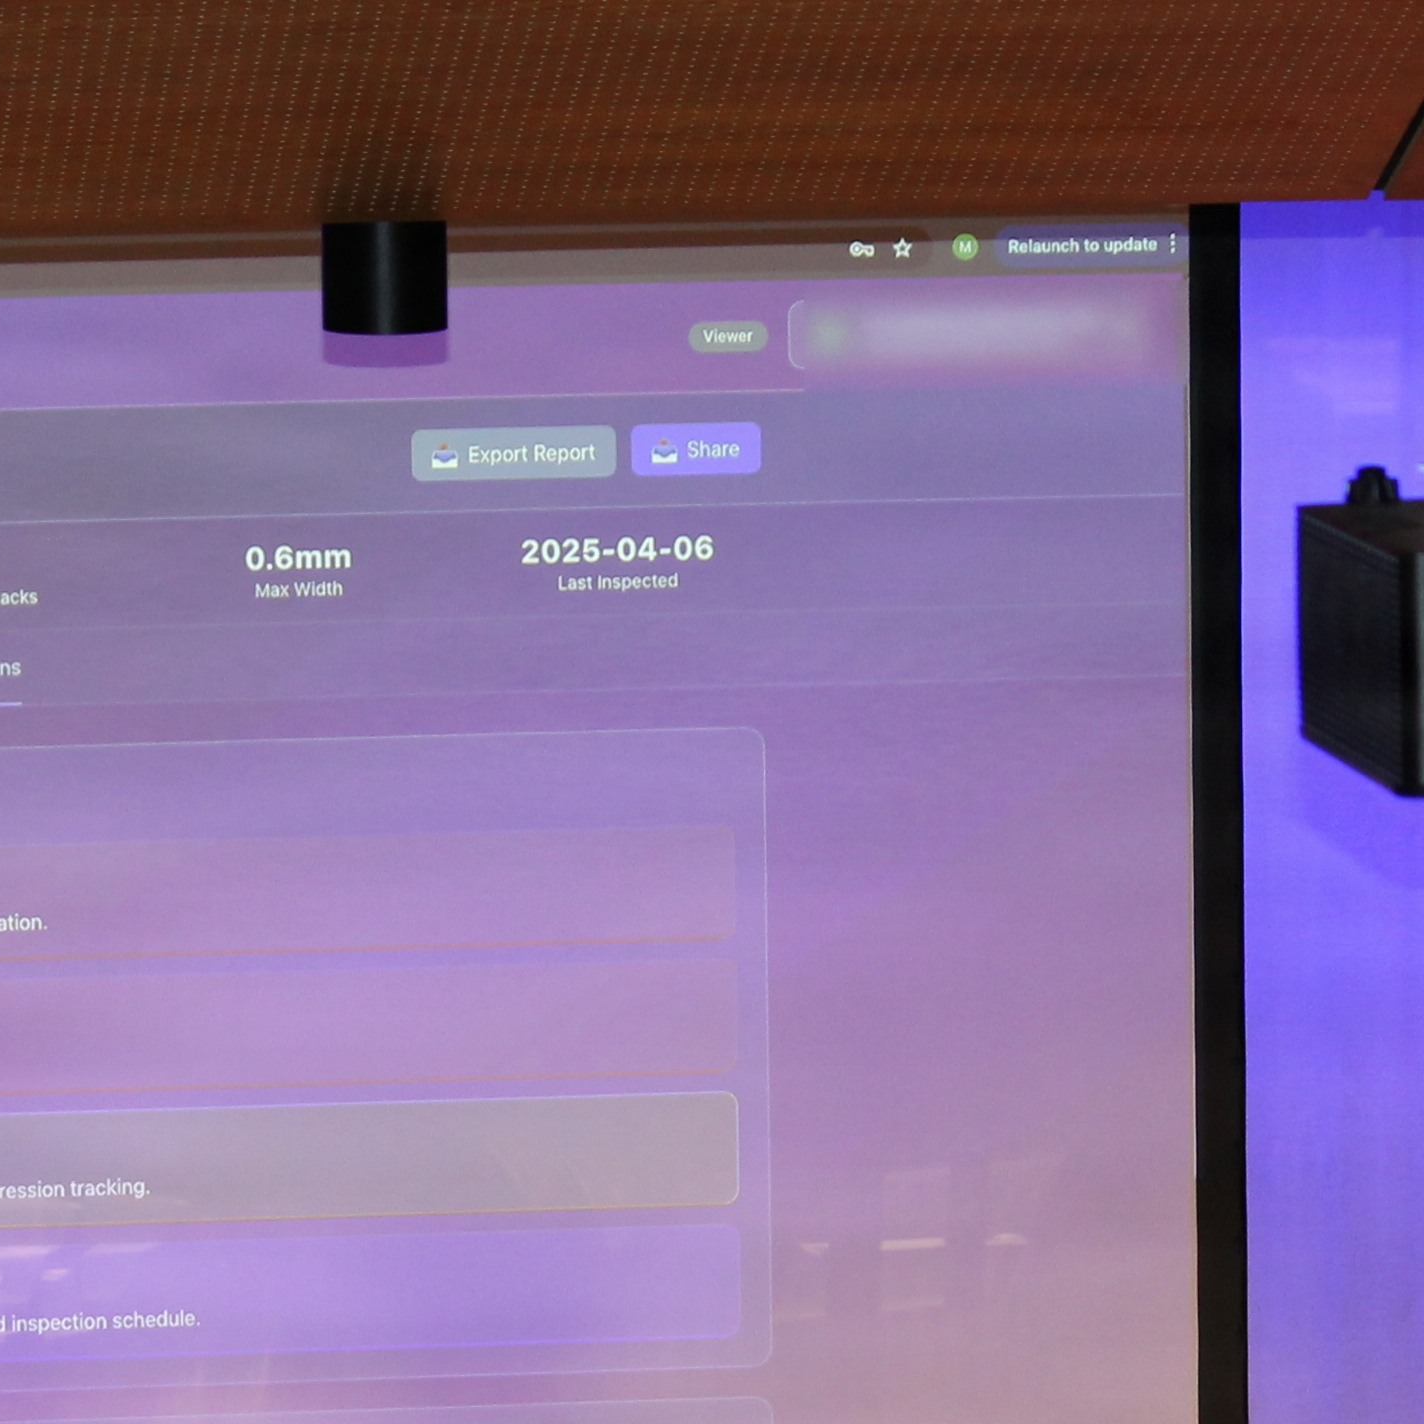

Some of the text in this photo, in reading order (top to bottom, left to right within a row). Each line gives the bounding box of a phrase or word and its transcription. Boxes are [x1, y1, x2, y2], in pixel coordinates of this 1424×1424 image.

[958, 238, 973, 254] M
[1008, 236, 1158, 255] Relaunch to update
[702, 328, 754, 344] Viewer
[468, 443, 596, 466] Export Report
[687, 439, 740, 459] Share
[245, 545, 351, 571] 0.6mm
[521, 535, 714, 564] 2025-04-06
[255, 580, 343, 598] Max Width
[558, 572, 679, 592] Last Inspected
[69, 1177, 151, 1199] tracking.
[11, 1311, 108, 1335] inspection
[112, 1309, 201, 1329] schedule.
